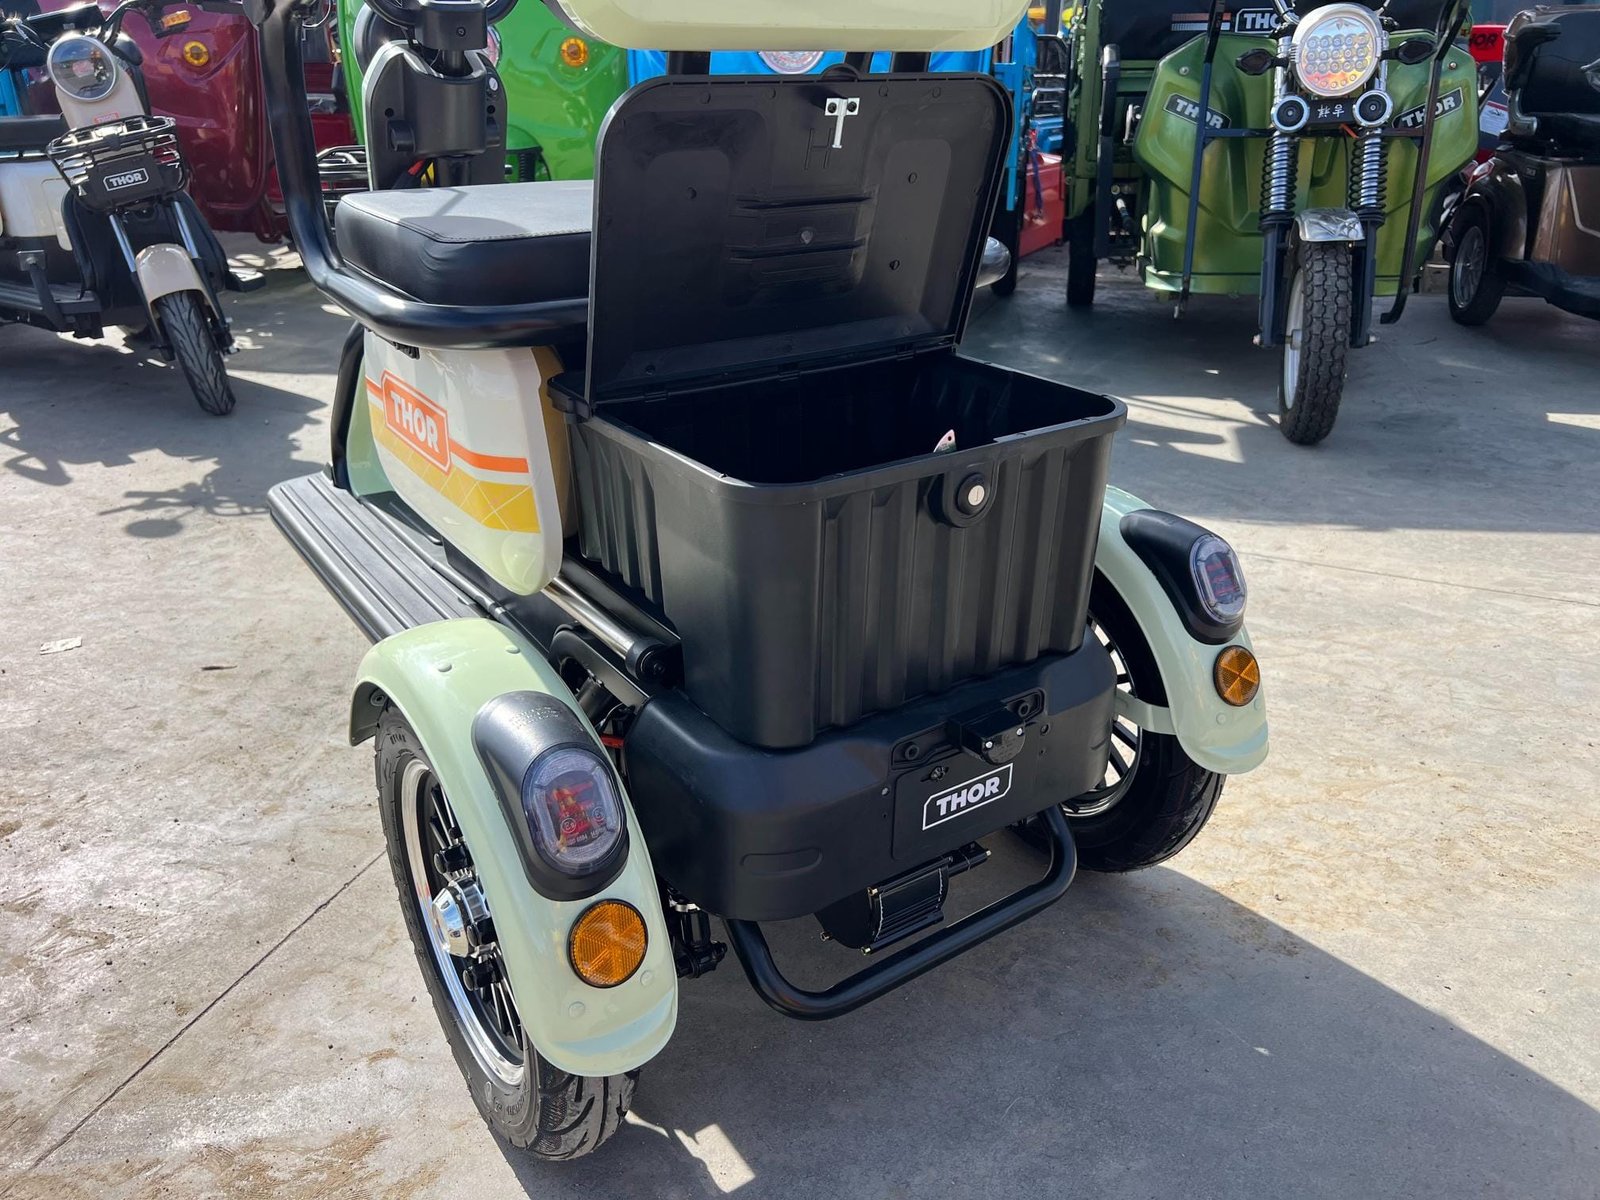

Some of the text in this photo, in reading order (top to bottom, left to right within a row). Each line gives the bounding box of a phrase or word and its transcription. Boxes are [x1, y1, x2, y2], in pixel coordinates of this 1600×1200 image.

[1243, 12, 1281, 29] THO
[109, 172, 143, 187] THOR
[390, 390, 441, 454] THOR
[936, 776, 1001, 816] THOR
